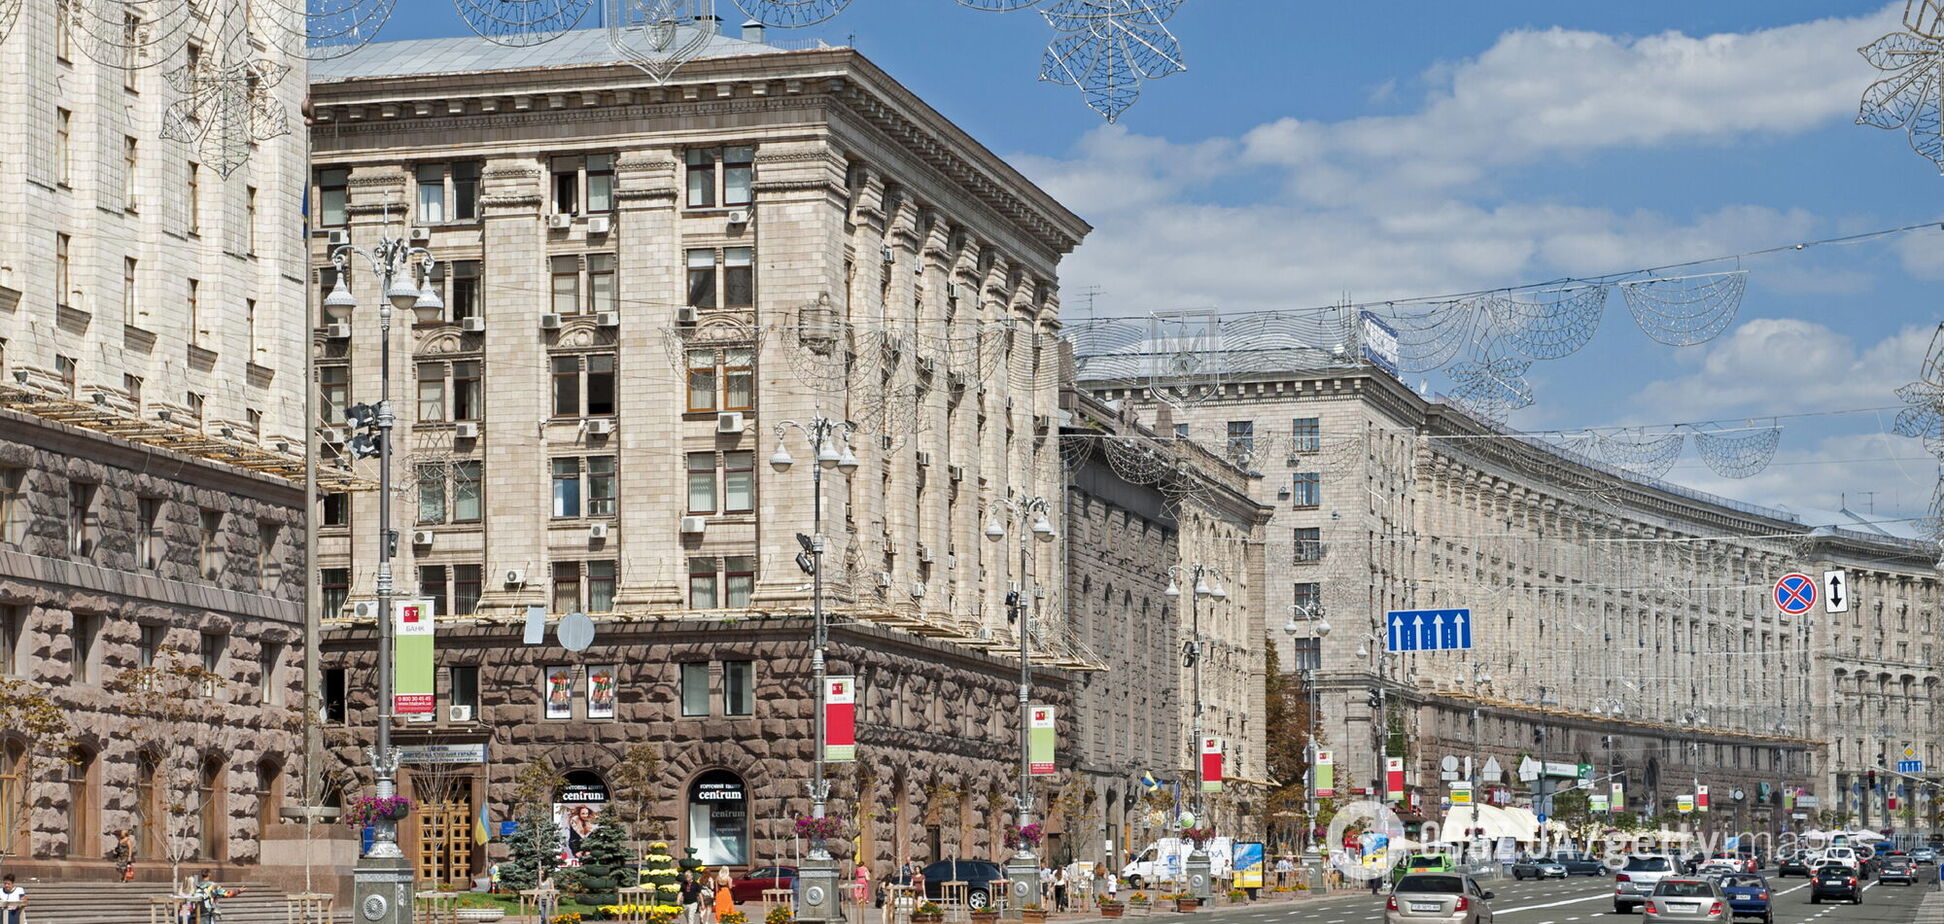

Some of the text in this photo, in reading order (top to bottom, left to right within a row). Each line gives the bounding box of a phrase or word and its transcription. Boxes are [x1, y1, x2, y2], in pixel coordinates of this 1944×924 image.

[562, 791, 604, 801] centrum
[698, 790, 742, 800] centrum
[711, 809, 746, 818] centrum
